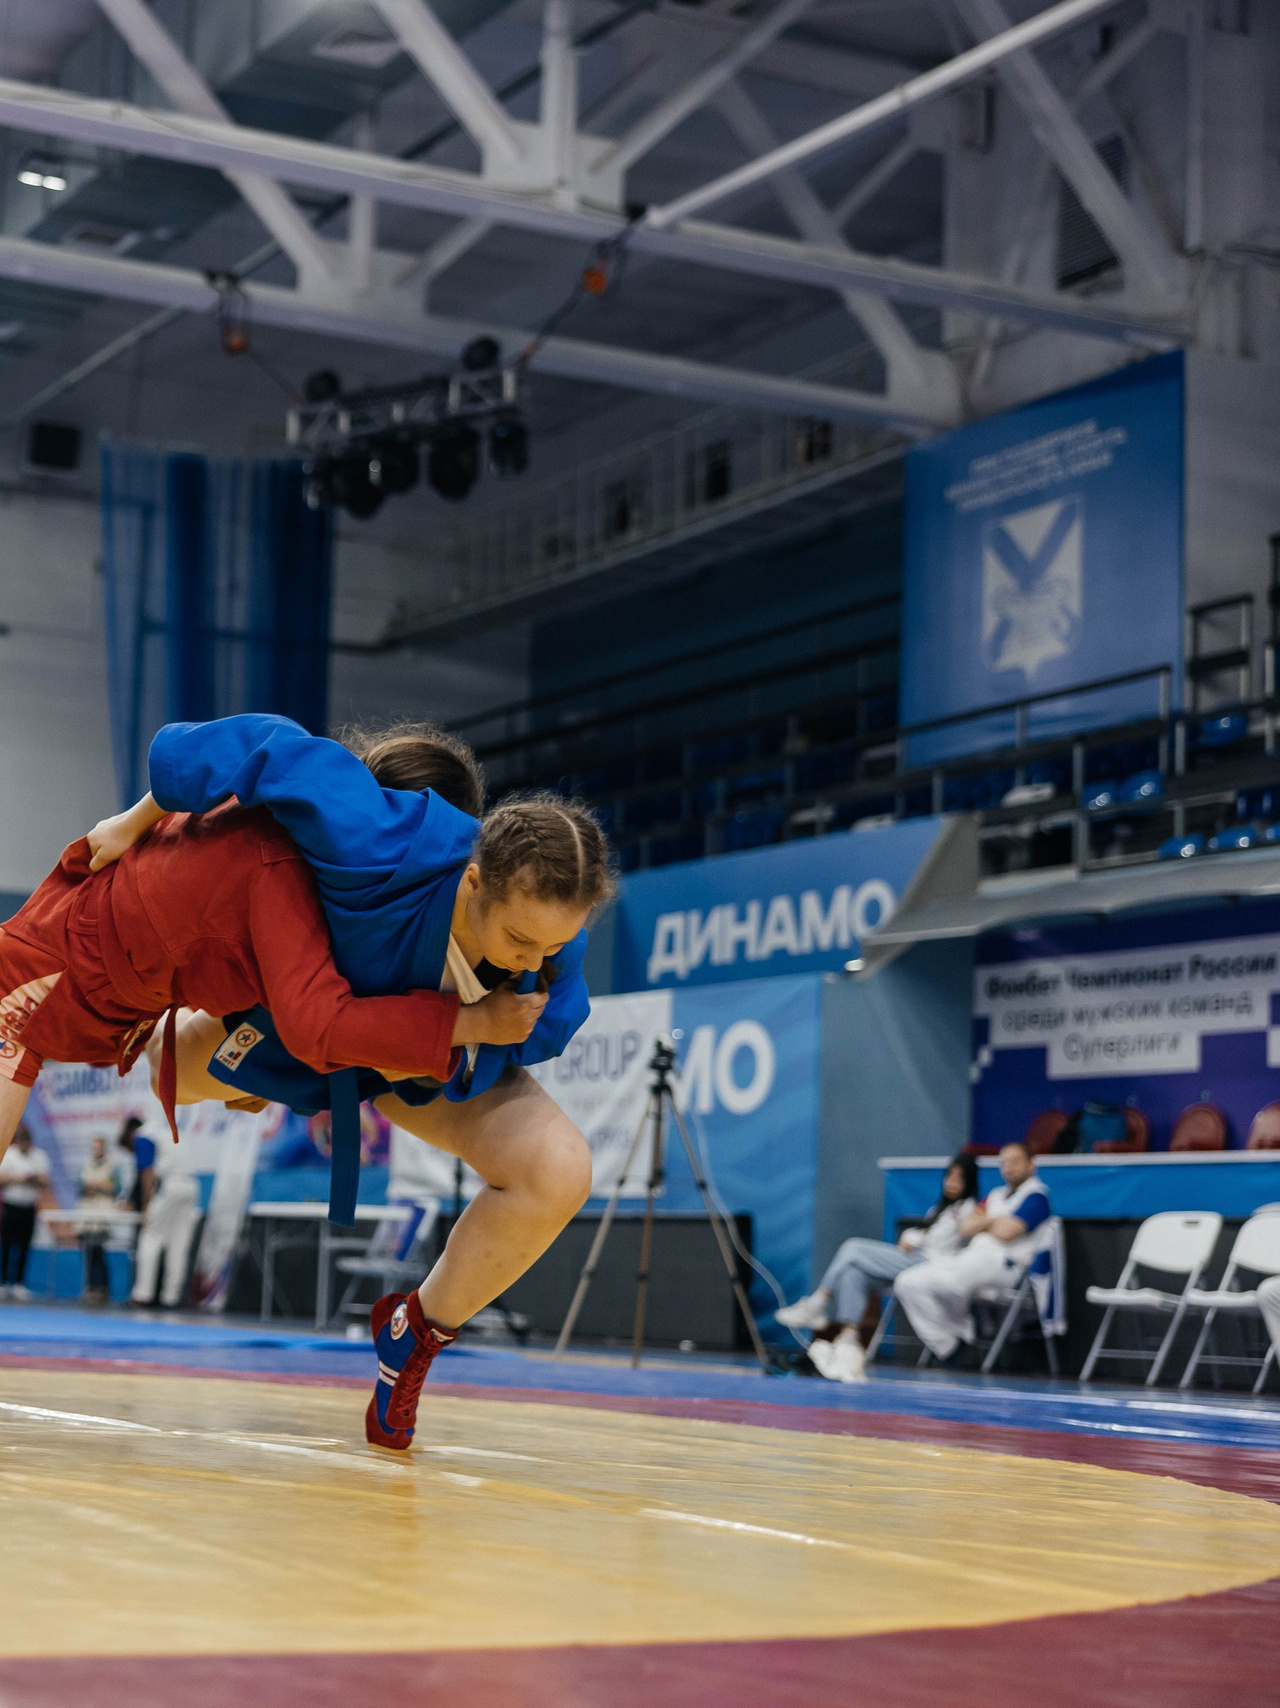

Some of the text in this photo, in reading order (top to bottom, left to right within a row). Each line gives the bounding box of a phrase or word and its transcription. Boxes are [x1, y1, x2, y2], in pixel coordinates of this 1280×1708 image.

[647, 879, 896, 983] ДИНАМО
[985, 952, 1277, 999] Фонбет Чемпионат России
[1002, 991, 1255, 1032] среди мужских команд
